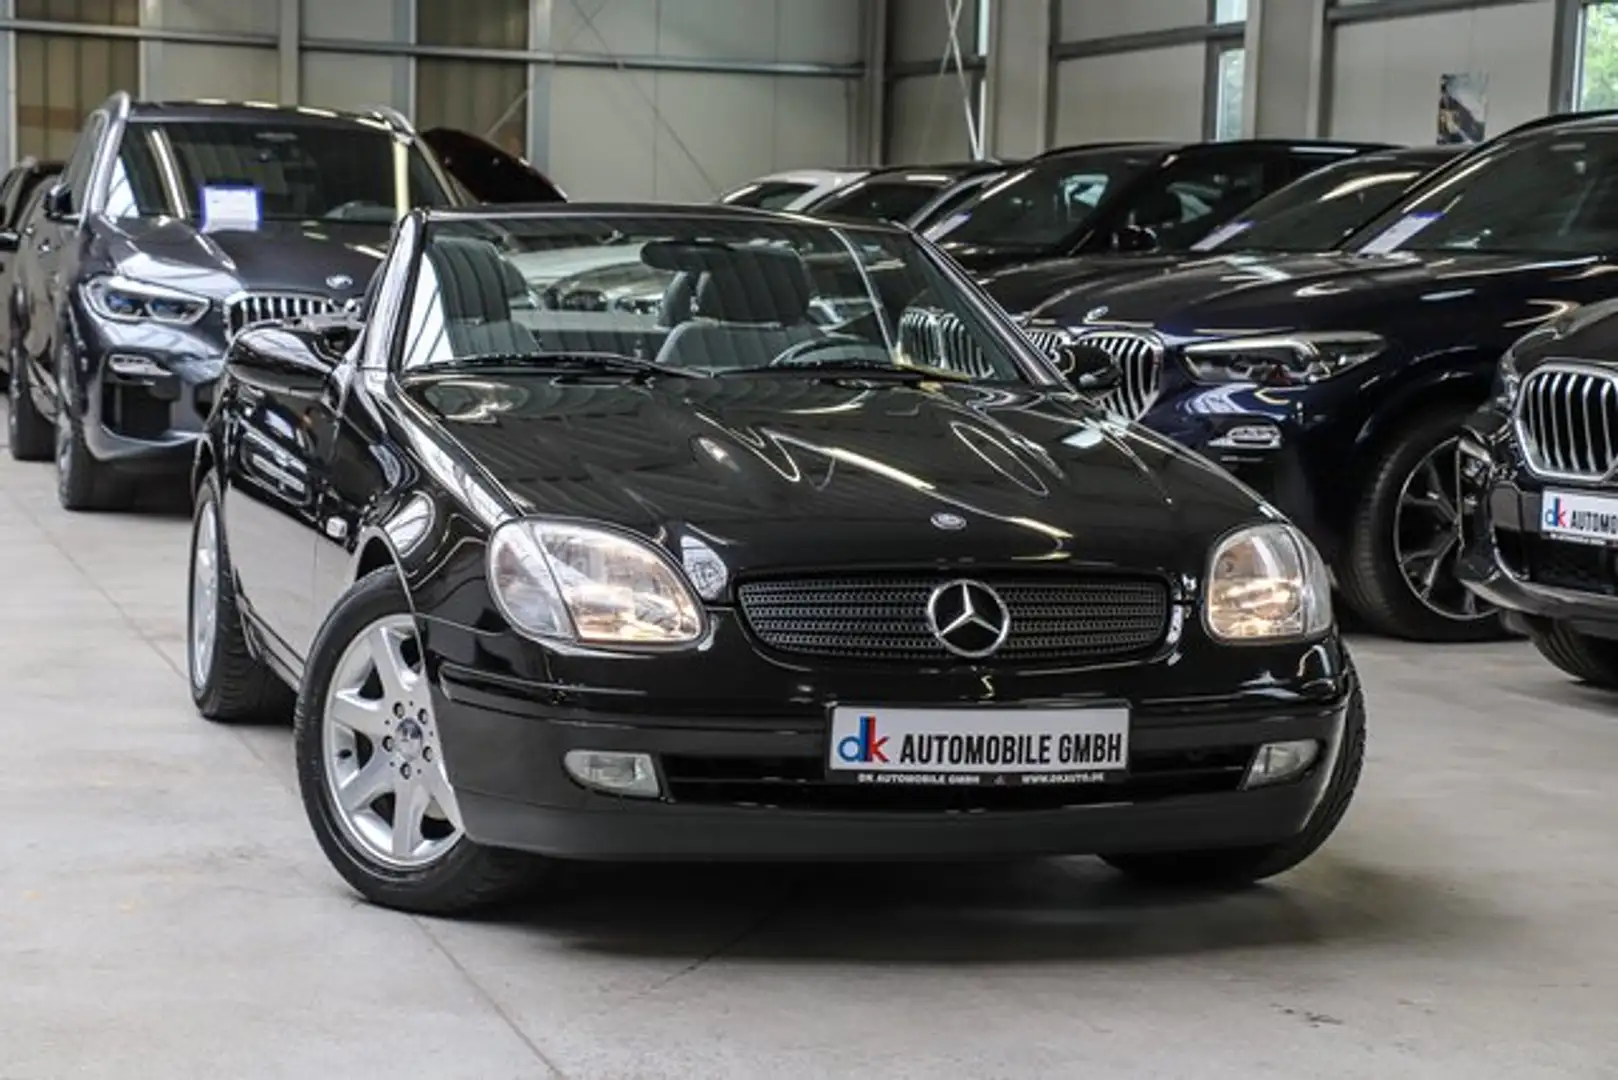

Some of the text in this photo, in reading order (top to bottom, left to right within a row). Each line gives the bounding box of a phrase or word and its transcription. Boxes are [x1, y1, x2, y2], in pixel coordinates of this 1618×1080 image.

[838, 716, 1122, 765] dk AUTOMOBILE GMBH
